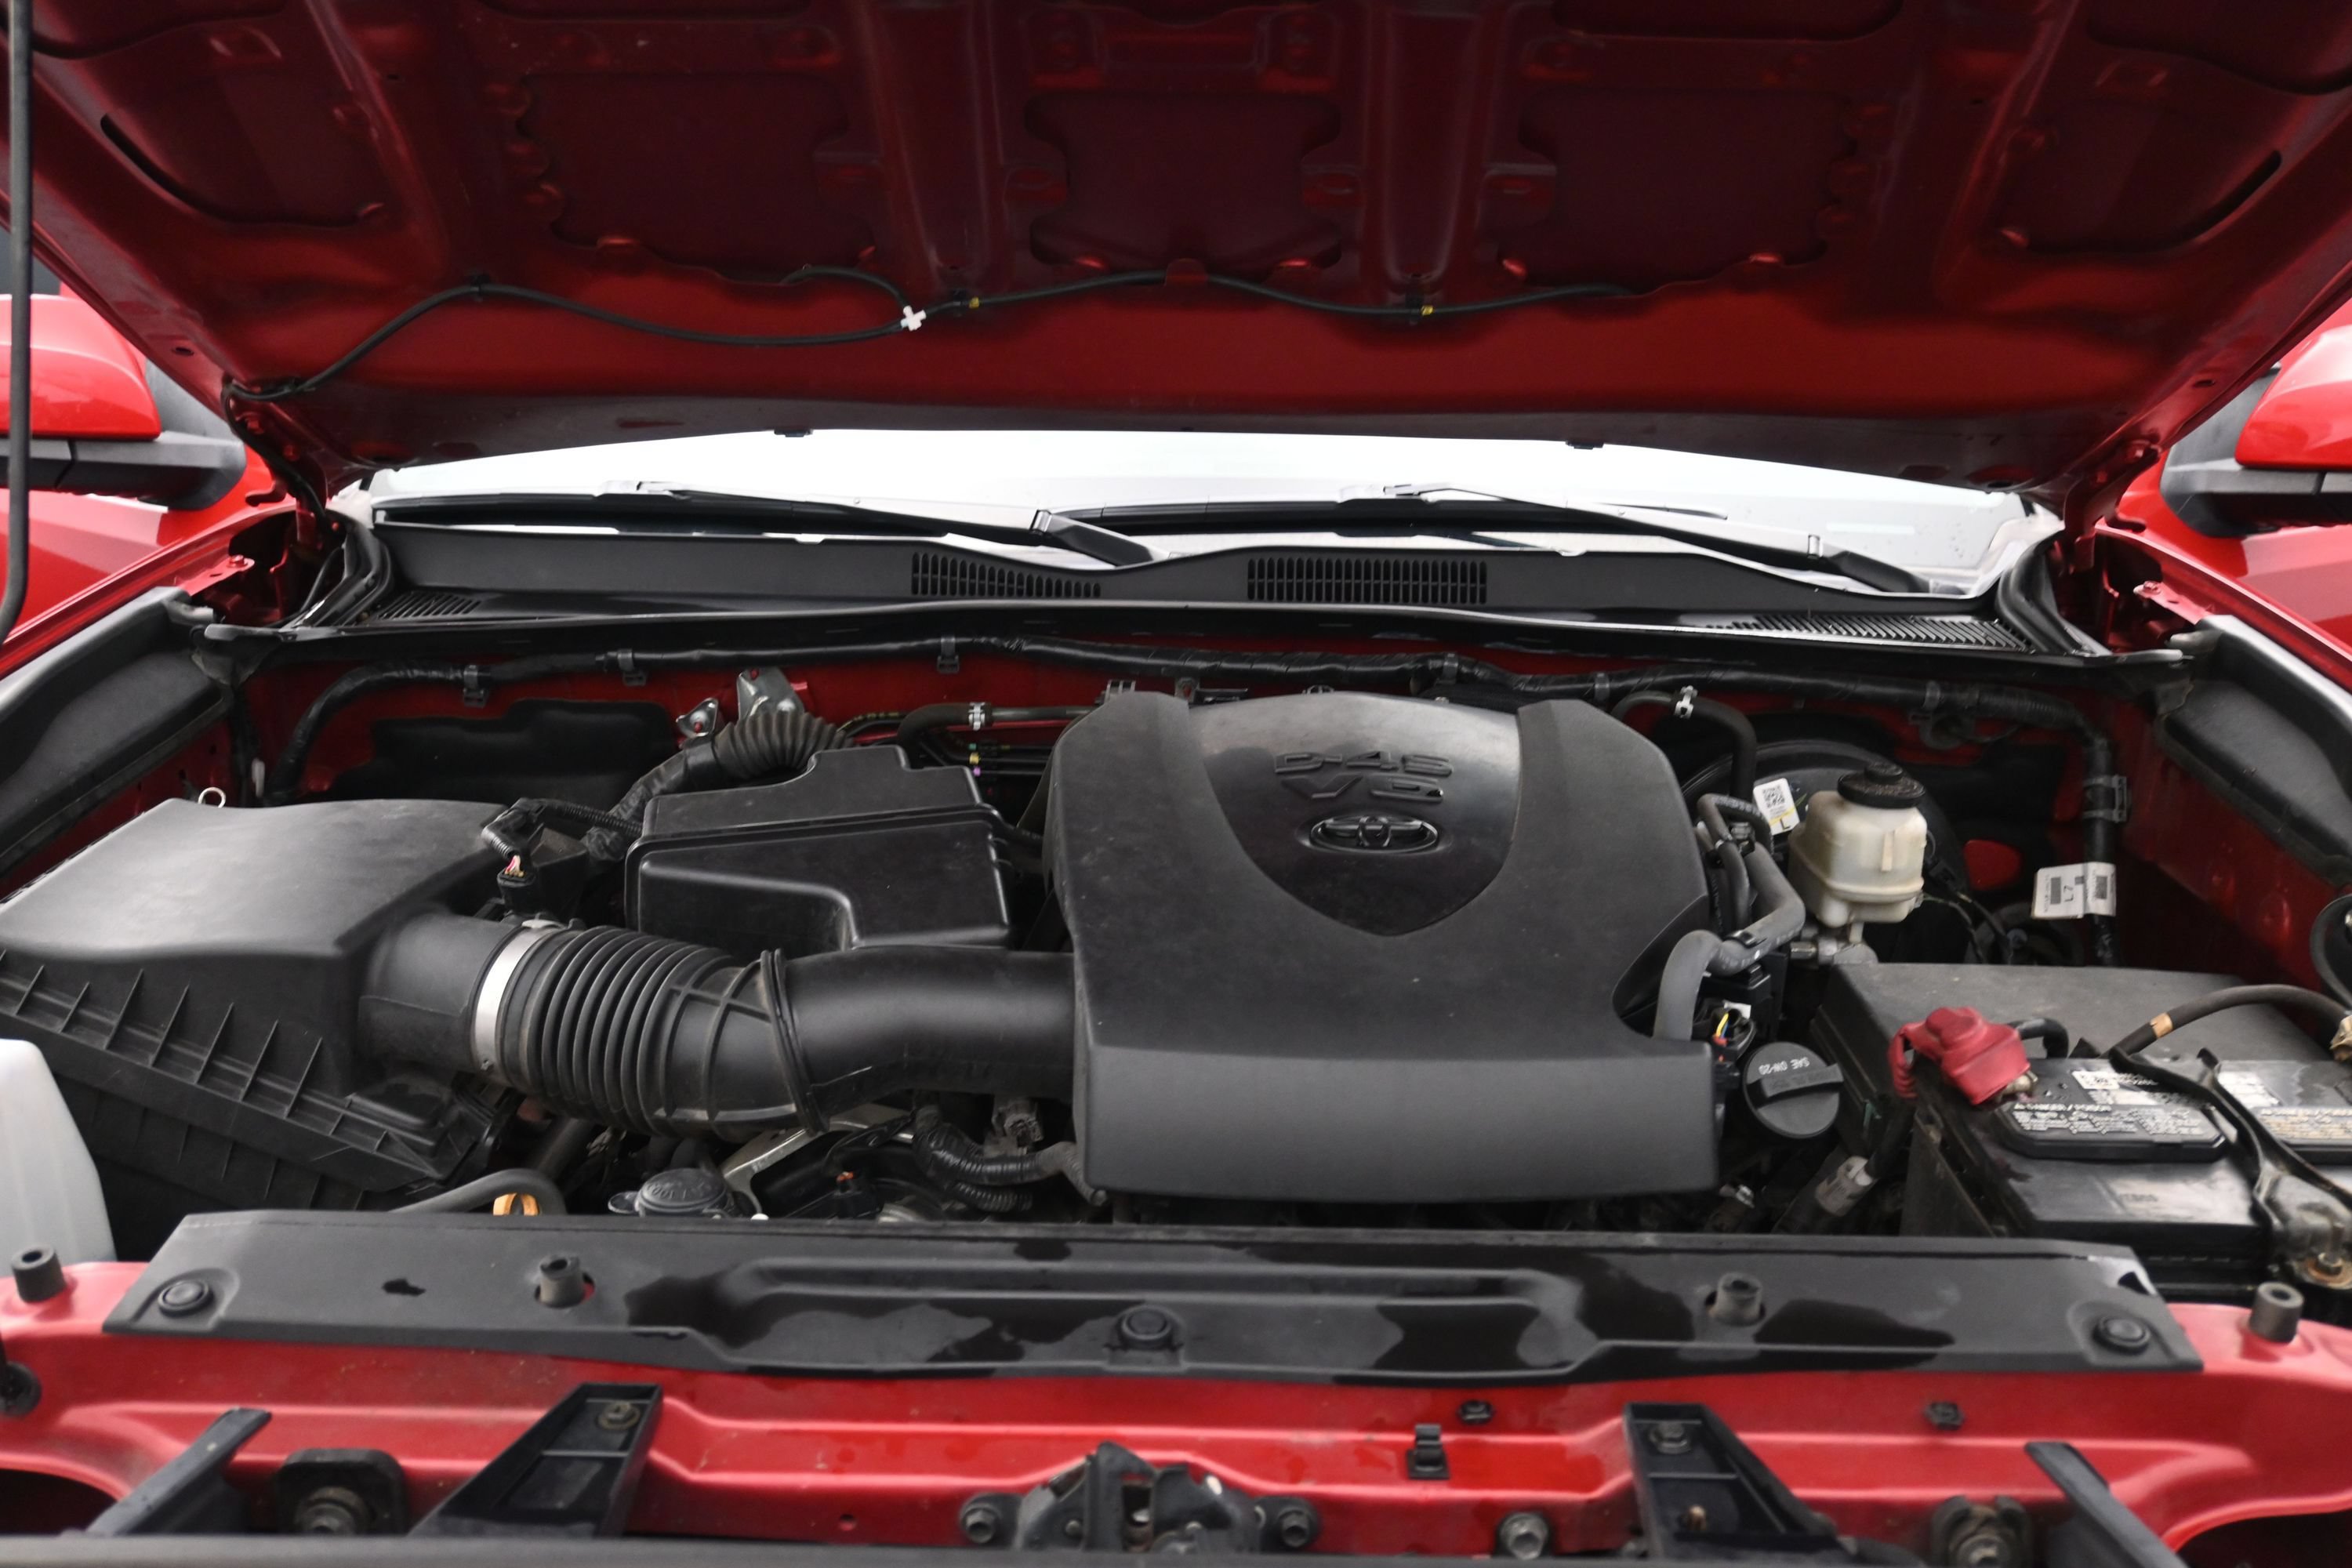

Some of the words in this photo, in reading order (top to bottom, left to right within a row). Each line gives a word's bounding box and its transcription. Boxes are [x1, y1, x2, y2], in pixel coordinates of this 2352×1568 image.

[1281, 773, 1443, 802] V6
[1780, 818, 1791, 830] L
[2063, 885, 2074, 902] L7
